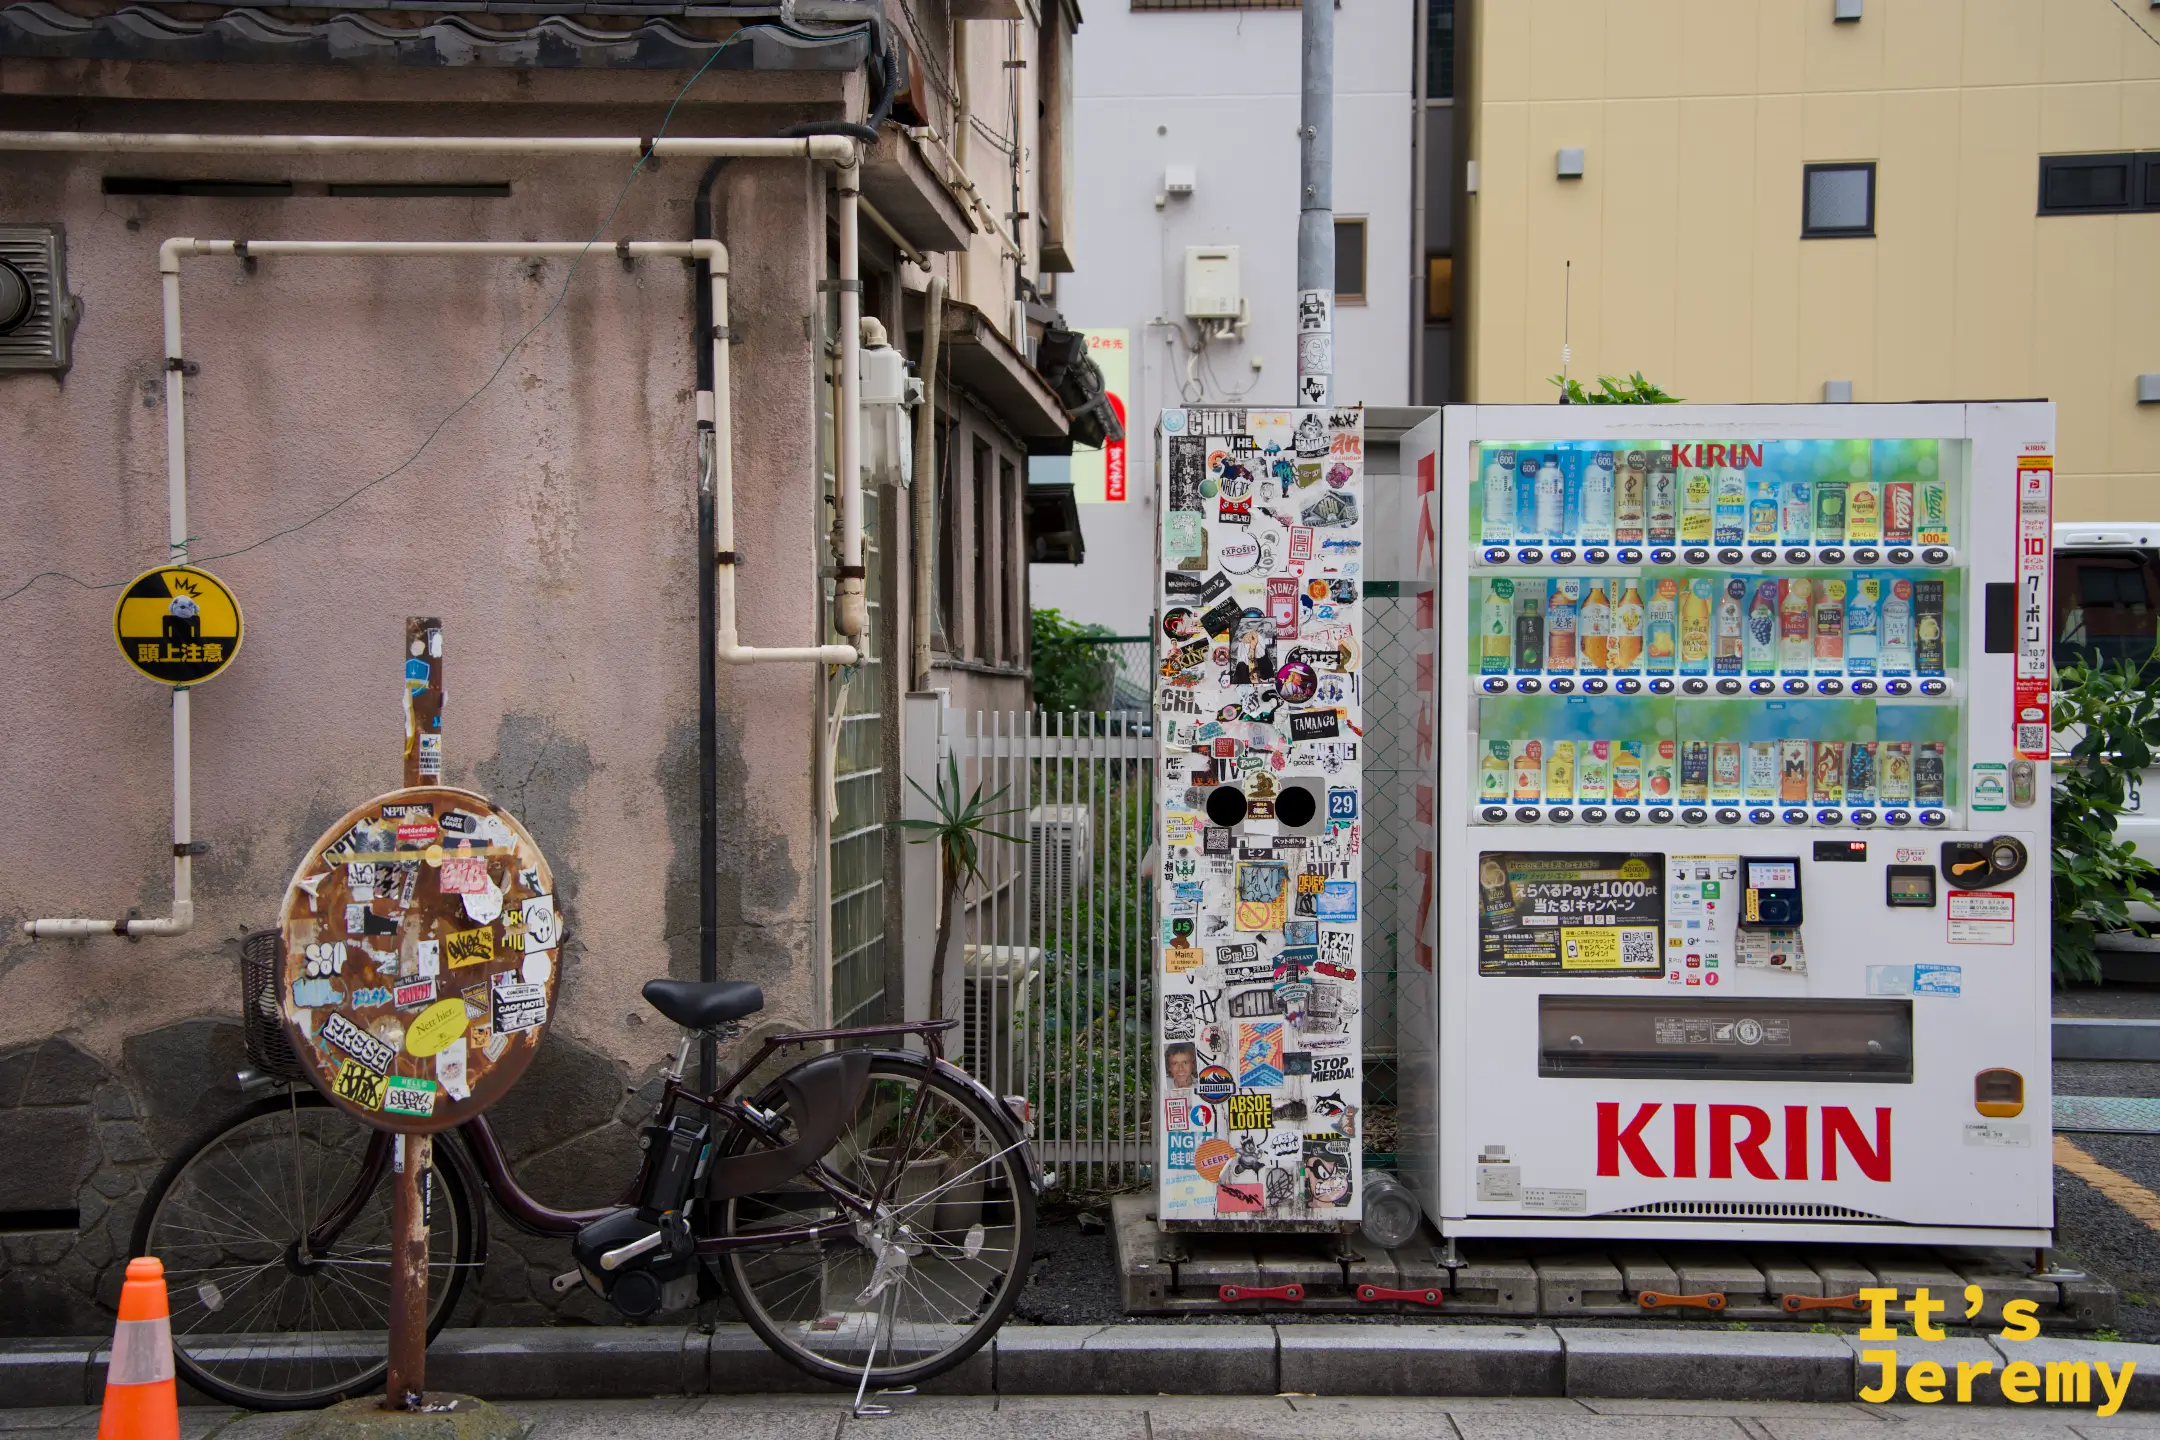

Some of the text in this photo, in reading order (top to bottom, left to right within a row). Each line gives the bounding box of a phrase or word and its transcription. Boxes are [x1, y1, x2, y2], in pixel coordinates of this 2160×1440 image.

[1672, 444, 1763, 468] KIRIN
[1897, 486, 1912, 529] Mets
[1928, 485, 1943, 524] Mets
[1922, 534, 1939, 543] 100
[2024, 538, 2043, 555] 10
[1221, 545, 1256, 556] EXPOSED
[1268, 583, 1298, 596] SYDNEY
[1650, 612, 1673, 620] FRUITS
[2026, 576, 2040, 642] クーポン
[138, 643, 223, 663] 頭上注意
[1294, 716, 1335, 730] TAMANGO
[1332, 795, 1353, 814] 29
[1175, 922, 1190, 932] J$
[415, 1008, 455, 1034] Nett hier.
[324, 1013, 393, 1075] FRESA
[1314, 1057, 1349, 1071] STOP
[402, 1078, 426, 1088] HELLO
[1311, 1068, 1354, 1082] MIERDA!
[1230, 1094, 1271, 1112] ABSOE
[1230, 1111, 1272, 1129] LOOTE
[1596, 1102, 1892, 1182] KIRIN
[1202, 1154, 1230, 1167] LEERS
